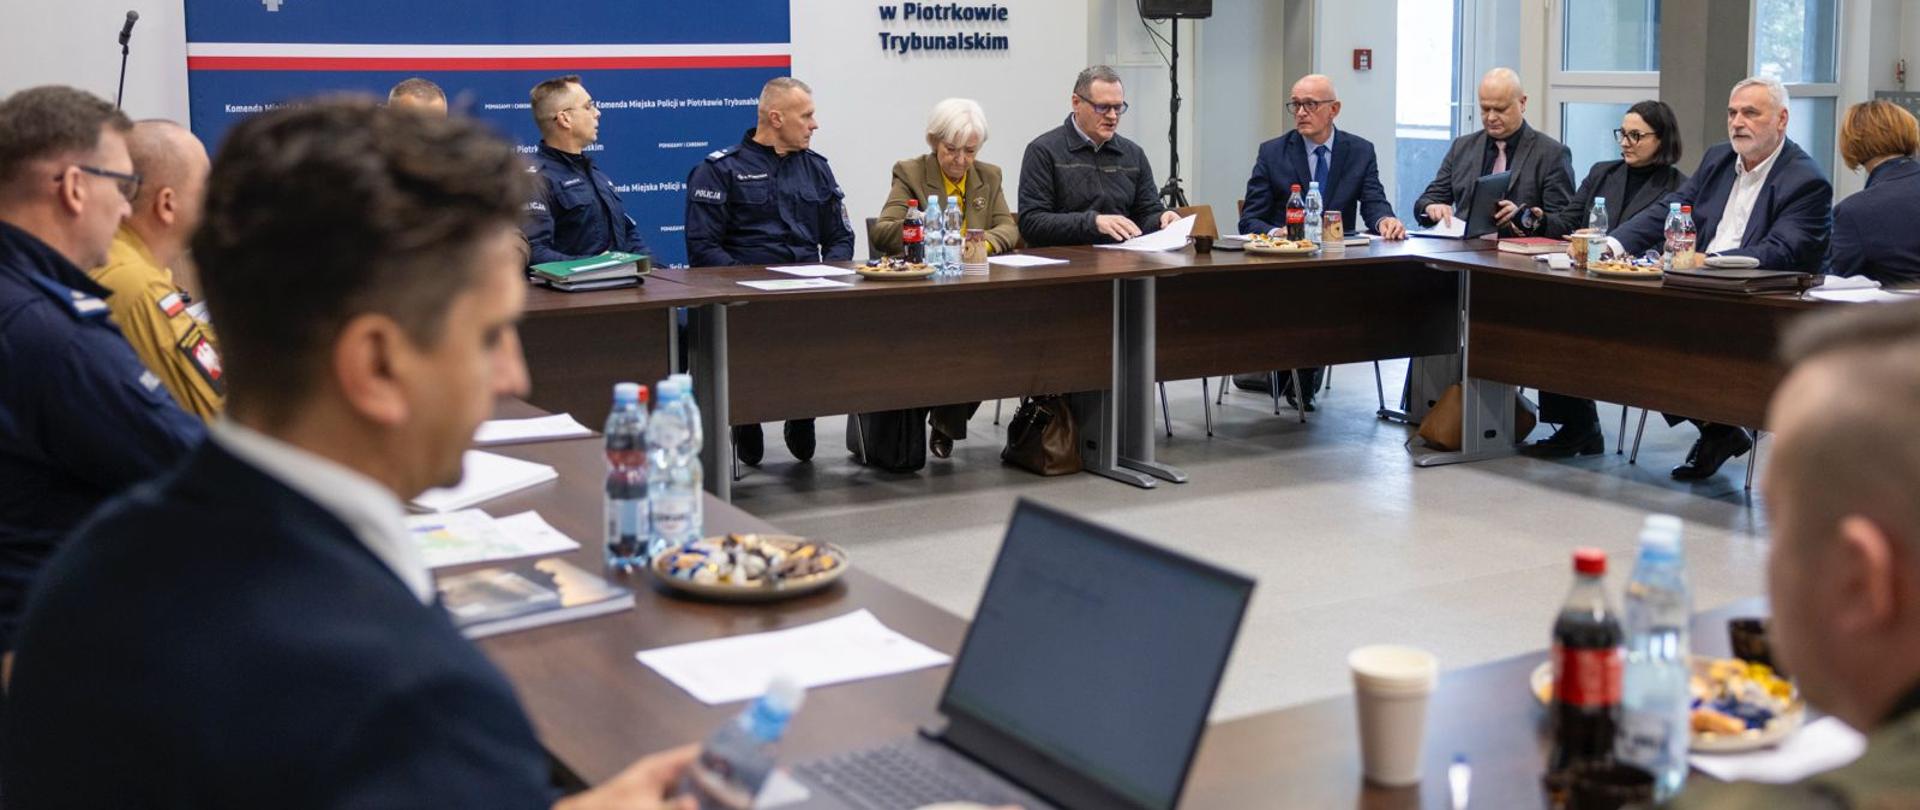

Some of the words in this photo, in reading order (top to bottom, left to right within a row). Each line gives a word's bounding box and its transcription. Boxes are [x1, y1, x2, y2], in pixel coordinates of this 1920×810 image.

[879, 5, 897, 21] w
[903, 2, 1009, 21] Piotrkowie
[878, 32, 1009, 54] Trybunalskim
[225, 104, 263, 113] Komenda
[596, 101, 628, 109] Komenda
[629, 100, 656, 109] Miejska
[657, 99, 679, 109] Policji
[687, 98, 723, 107] Piotrkowie
[724, 97, 760, 108] Trybunalsk
[516, 145, 539, 153] Piotrk
[631, 183, 658, 193] Miejska
[659, 181, 681, 192] Policji
[694, 189, 721, 200] POLICJA
